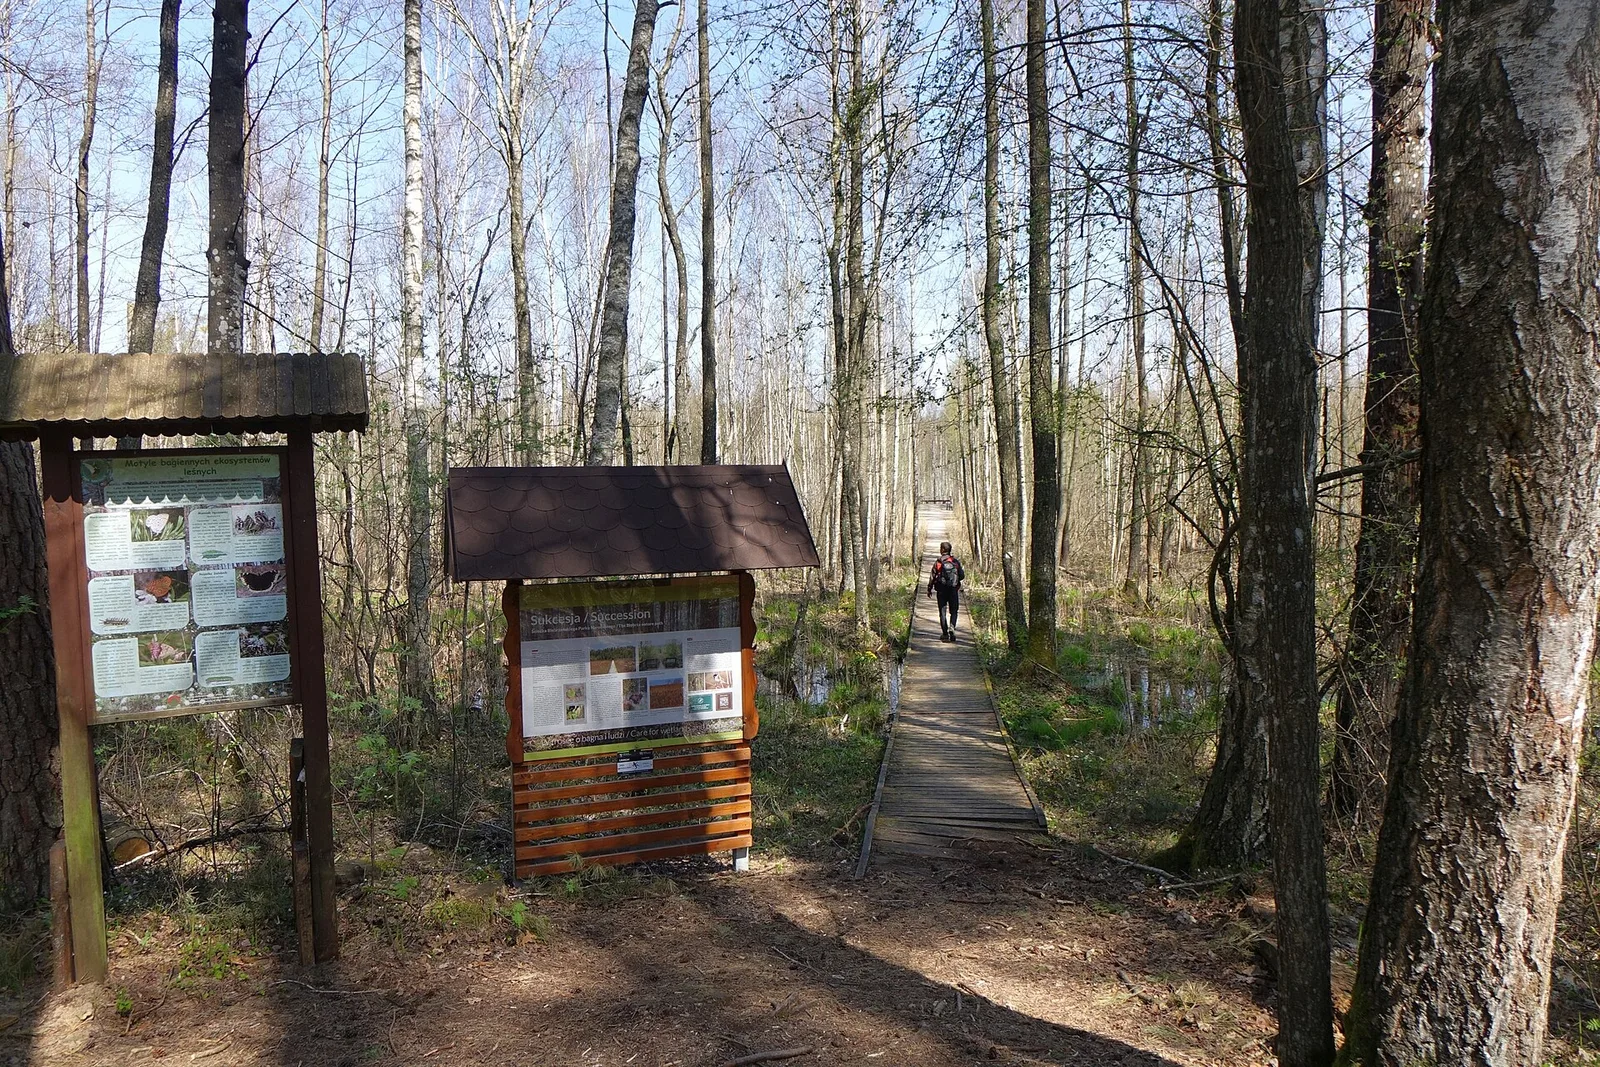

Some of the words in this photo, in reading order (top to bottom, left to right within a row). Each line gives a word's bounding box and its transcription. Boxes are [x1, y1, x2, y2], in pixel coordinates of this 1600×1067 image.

[125, 459, 156, 469] Motyle
[160, 458, 210, 469] bagiennych
[214, 455, 271, 465] ekosystemów
[183, 467, 217, 477] leśnych
[531, 613, 581, 626] Sukcesja
[591, 609, 651, 622] Succession
[581, 733, 604, 745] bagna
[607, 730, 625, 741] ludzi
[630, 729, 648, 738] Care
[649, 726, 660, 736] for
